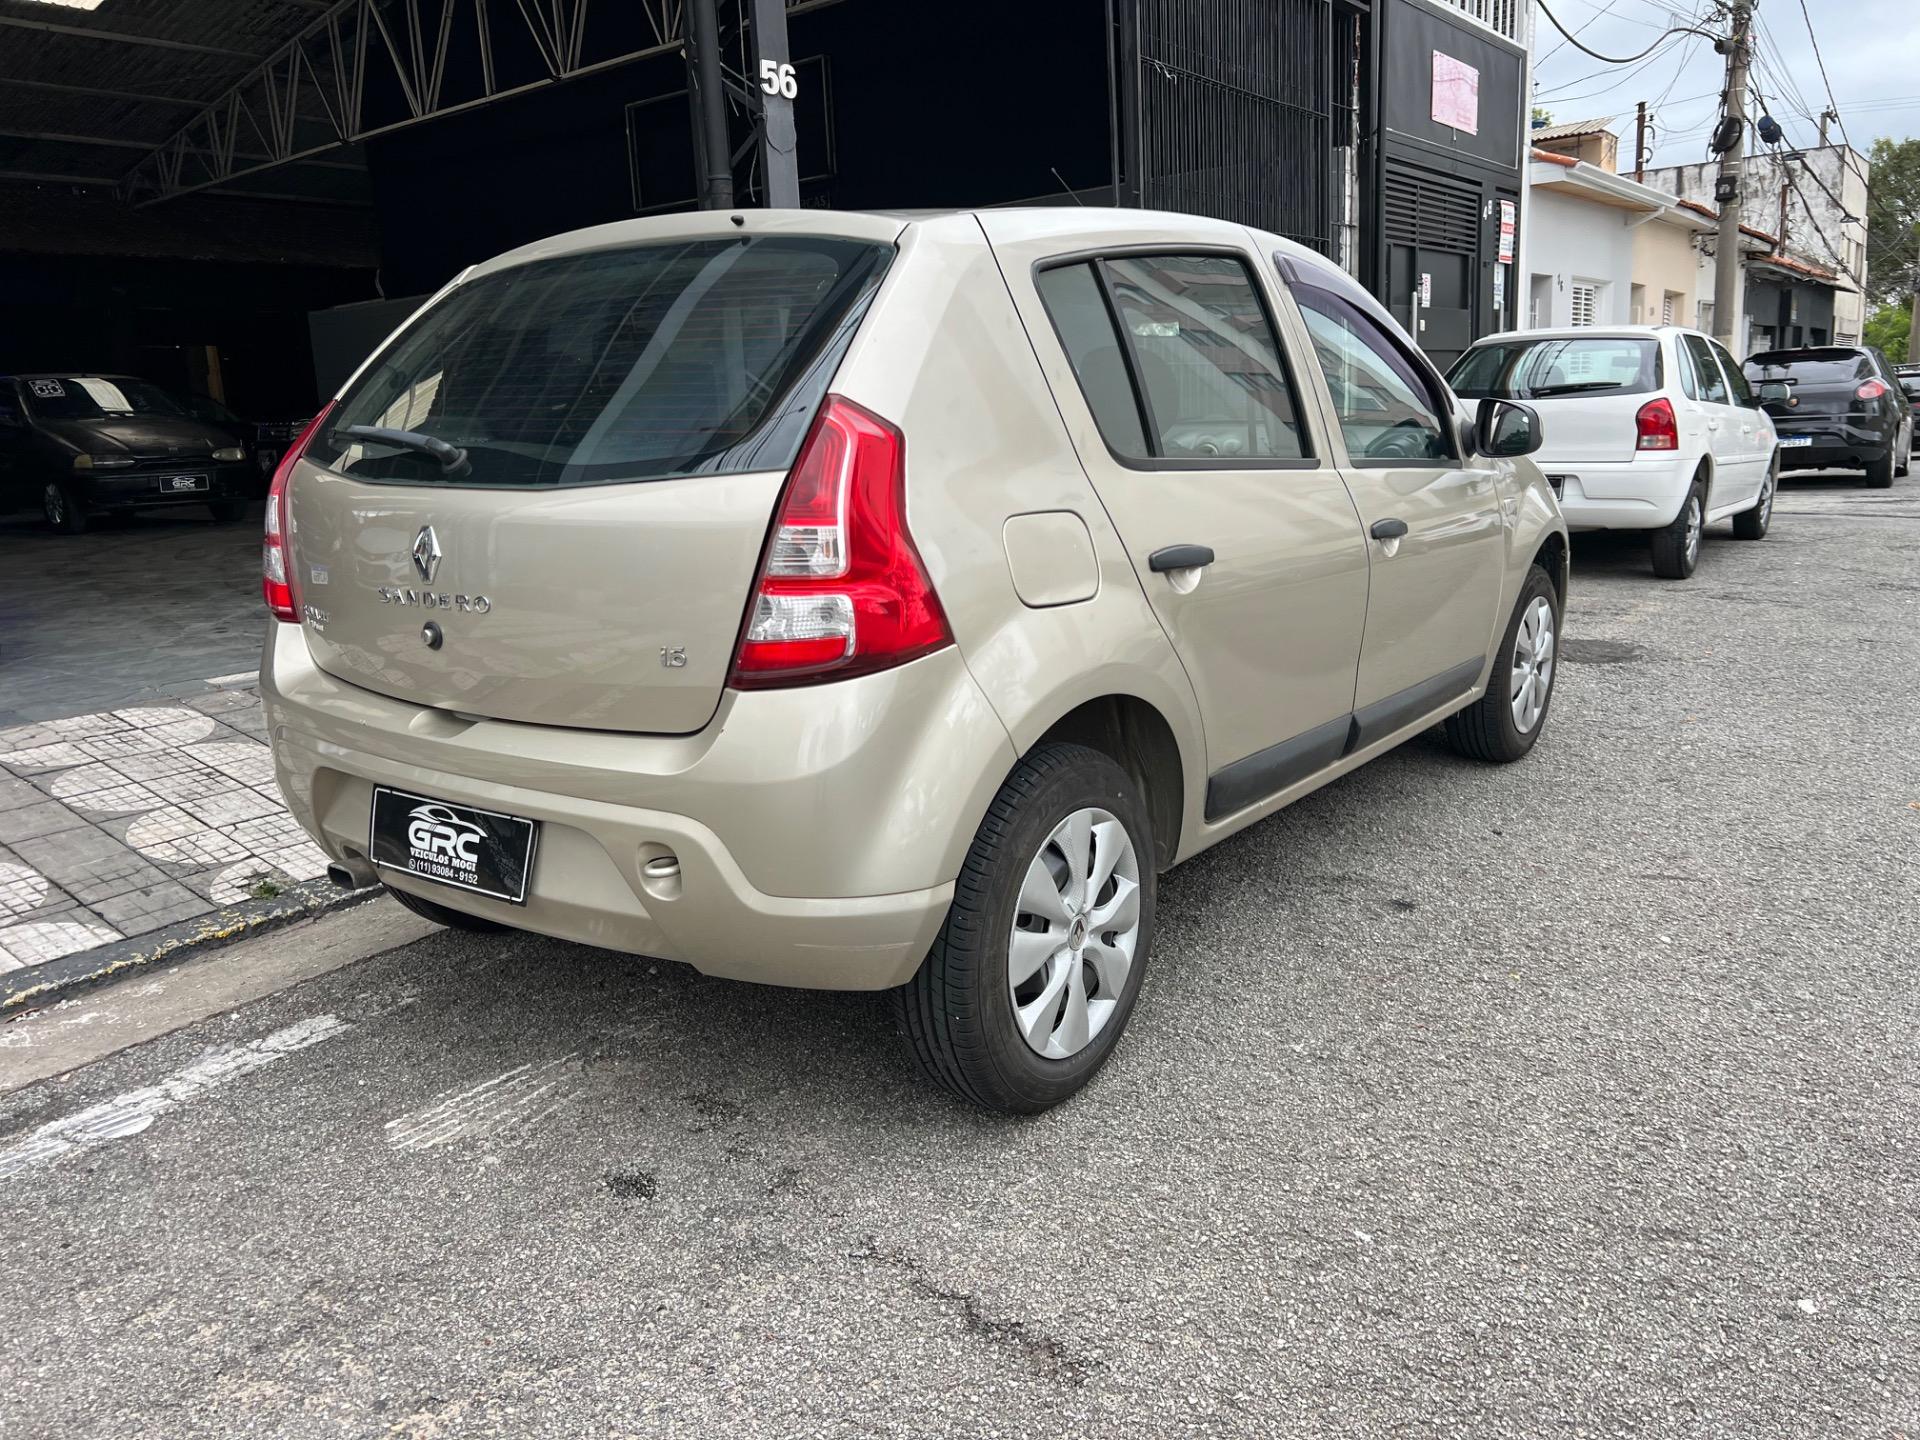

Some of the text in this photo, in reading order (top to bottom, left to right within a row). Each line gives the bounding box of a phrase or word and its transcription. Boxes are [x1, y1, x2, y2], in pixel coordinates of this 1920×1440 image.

[759, 59, 798, 99] 56
[1482, 199, 1493, 221] 48
[378, 587, 492, 614] SANDERO
[408, 819, 480, 863] GRC
[409, 846, 476, 872] VEICULOS MOGI
[458, 873, 479, 885] 9152
